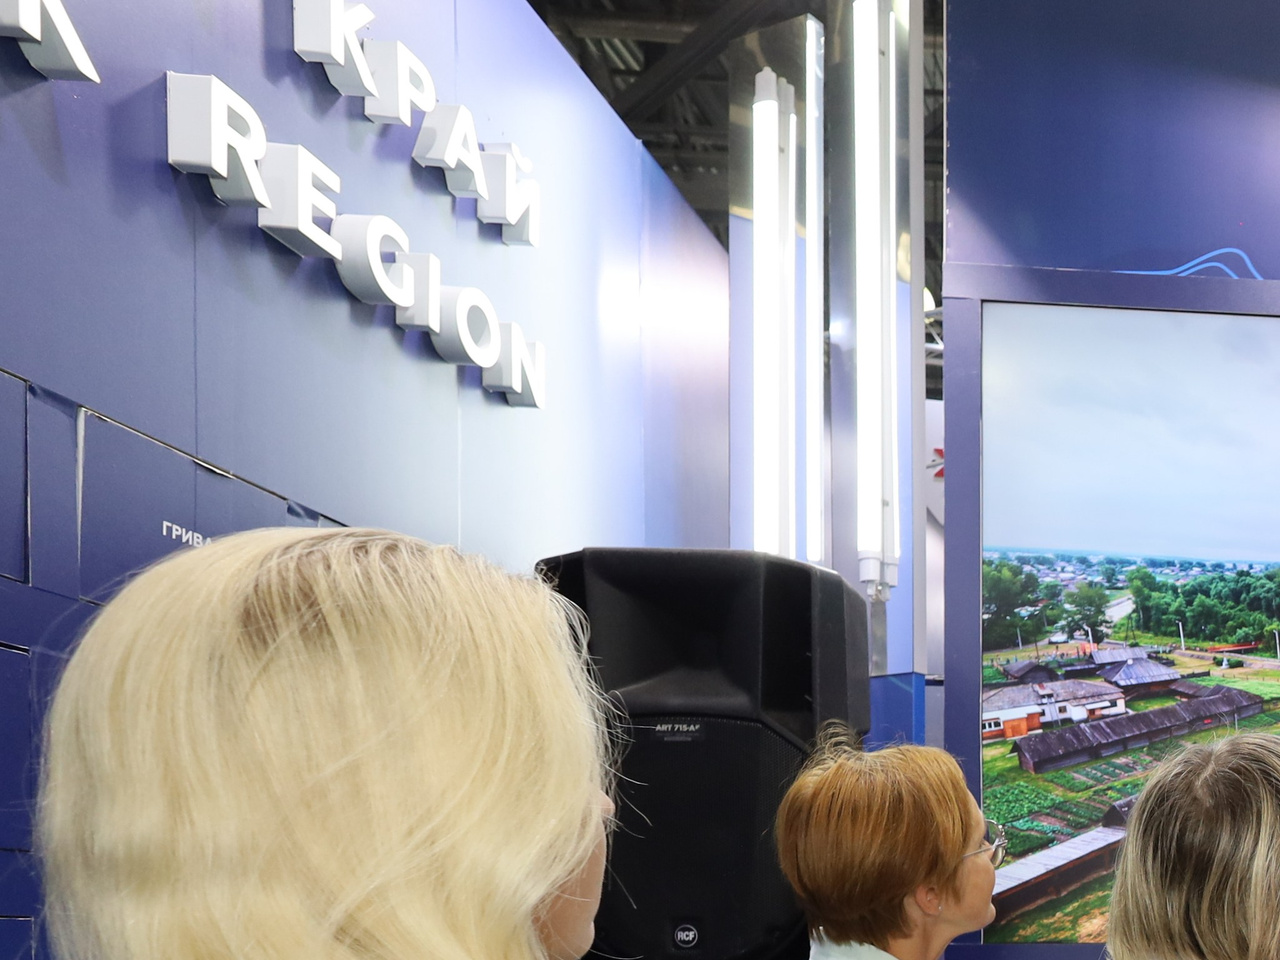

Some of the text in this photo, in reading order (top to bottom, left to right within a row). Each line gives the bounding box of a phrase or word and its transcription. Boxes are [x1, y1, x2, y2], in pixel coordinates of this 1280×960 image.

[326, 0, 541, 249] КРАЙ
[208, 73, 546, 410] REGION
[655, 724, 672, 732] ART
[677, 931, 695, 941] RCF
